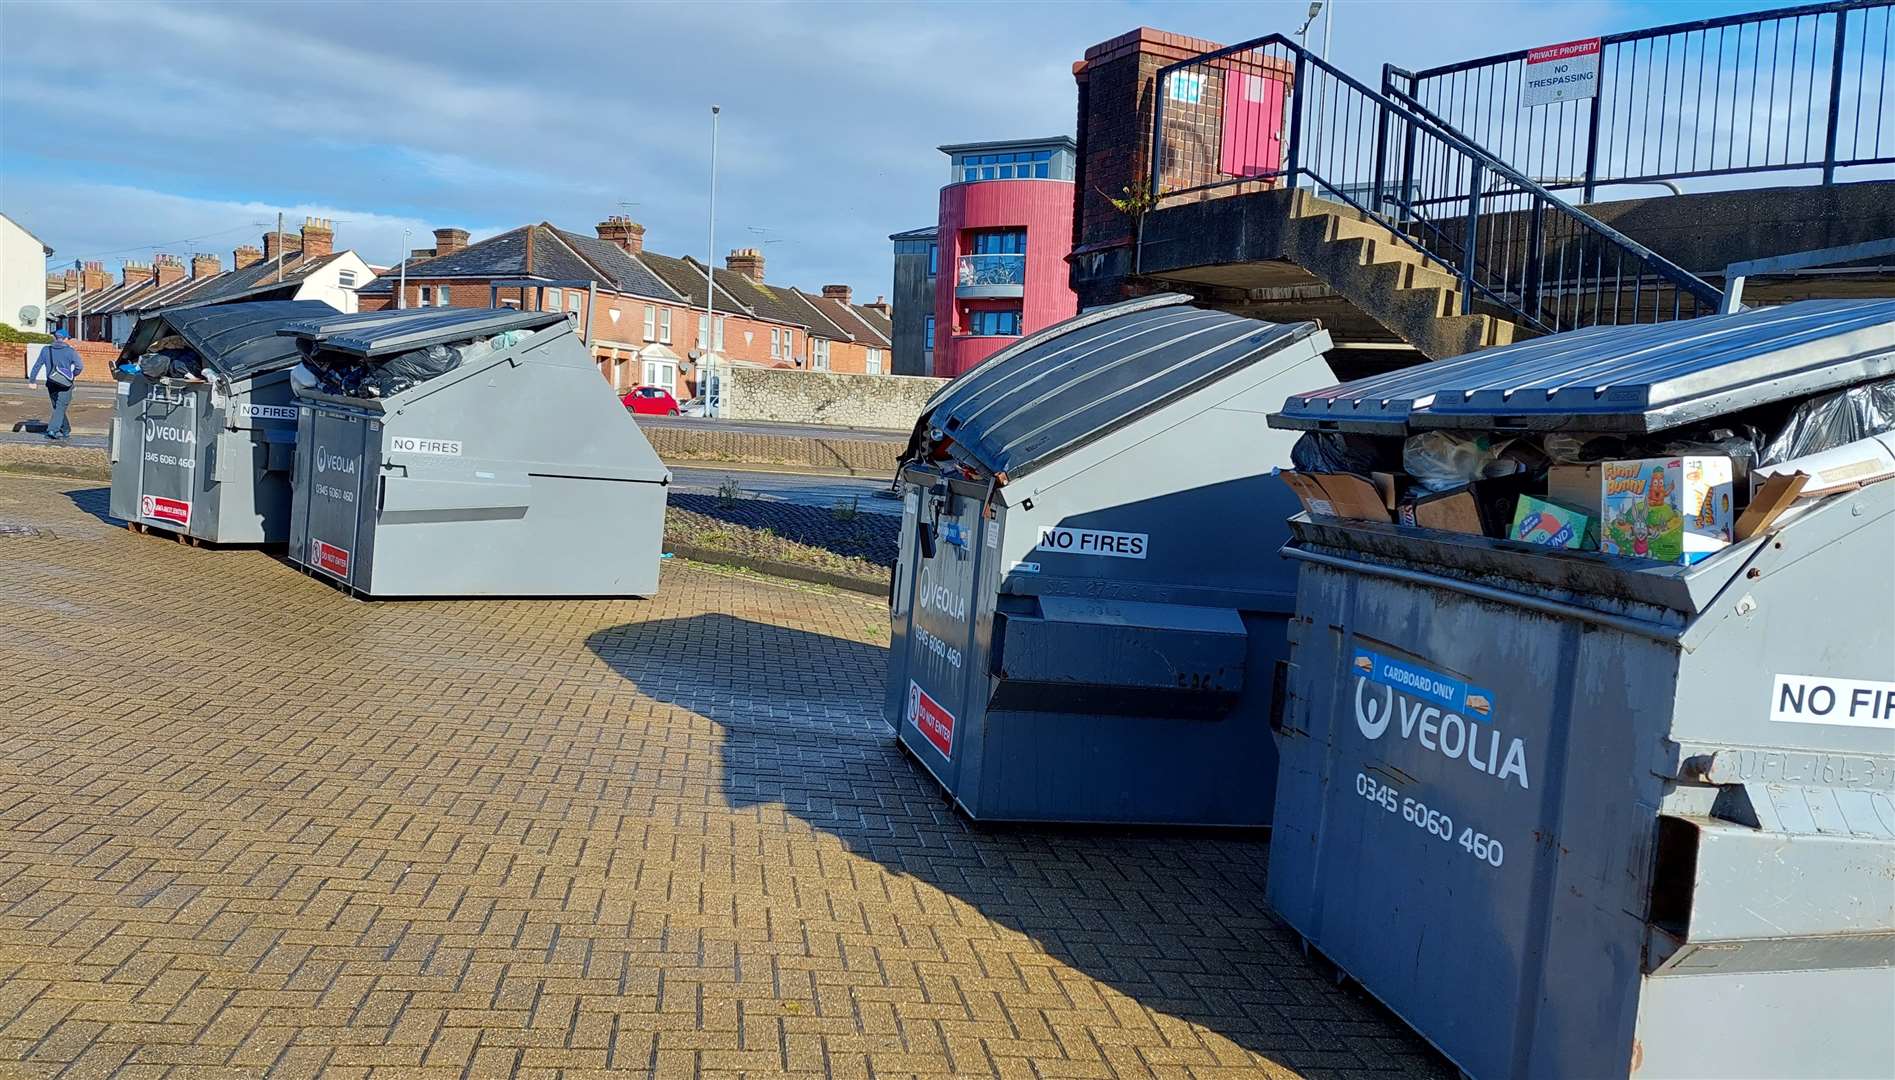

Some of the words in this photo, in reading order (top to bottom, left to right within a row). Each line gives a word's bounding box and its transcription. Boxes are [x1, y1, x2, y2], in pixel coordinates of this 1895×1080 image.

[1529, 48, 1558, 61] PRIVATE
[1559, 41, 1598, 56] PROPERTY
[1528, 71, 1594, 88] TRESPASSING
[1554, 64, 1569, 74] NO
[242, 406, 260, 415] NO
[262, 407, 296, 418] FIRES
[156, 425, 196, 444] VEOLIA
[394, 440, 415, 450] NO
[419, 441, 459, 453] FIRES
[178, 457, 195, 469] 460
[327, 453, 355, 474] VEOLIA
[1041, 531, 1073, 549] NO
[1080, 533, 1144, 555] FIRES
[931, 581, 965, 623] VEOLIA
[915, 623, 929, 646] 0345
[929, 635, 945, 658] 6060
[947, 647, 962, 668] 460
[1383, 665, 1431, 692] CARDBOARD
[1432, 681, 1455, 700] ONLY
[1779, 683, 1836, 716] NO
[920, 704, 926, 720] DO
[926, 710, 935, 729] NOT
[935, 719, 950, 742] ENTER
[1399, 696, 1529, 789] VEOLIA
[1356, 773, 1398, 813] 0345
[1402, 797, 1453, 841] 6060
[1459, 828, 1504, 867] 460
